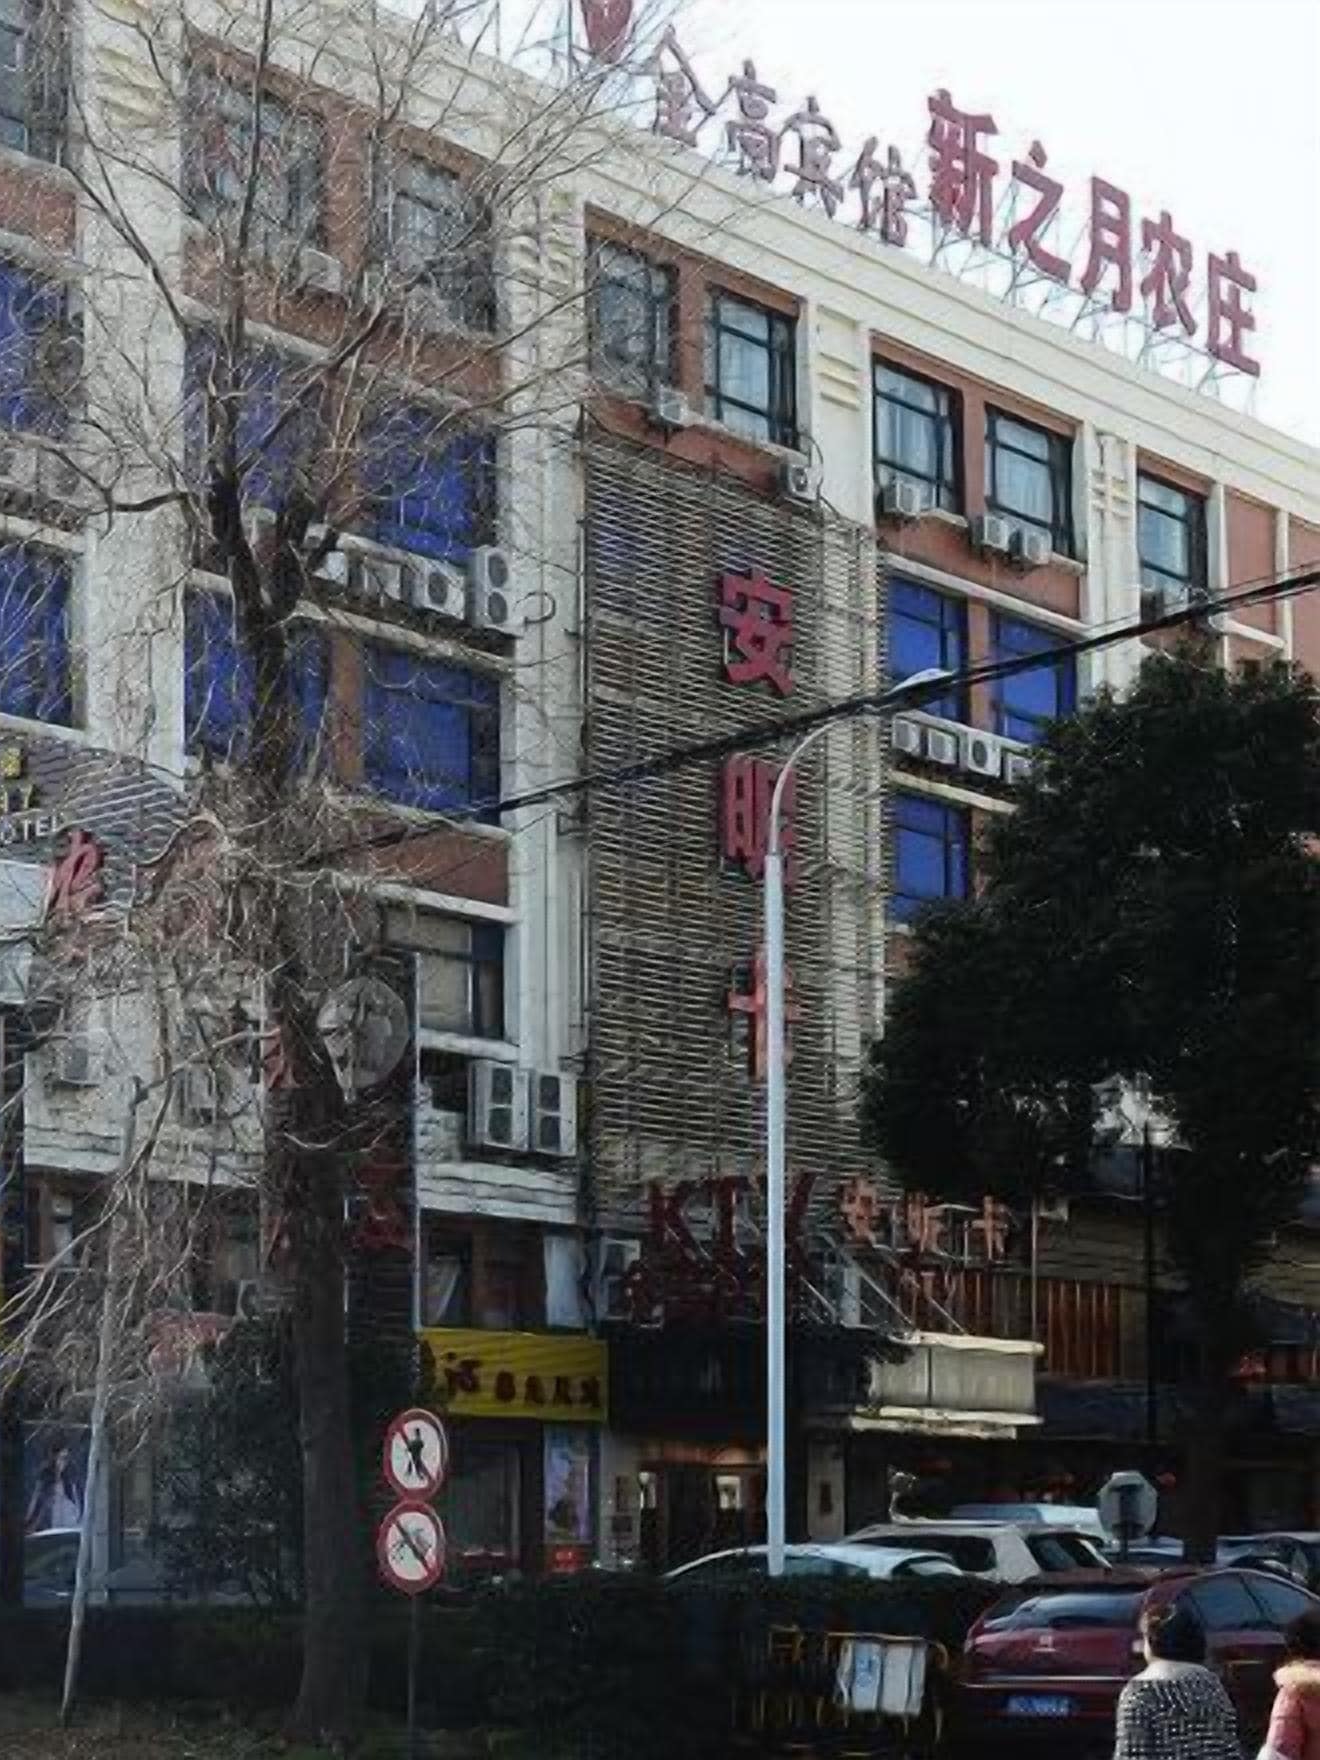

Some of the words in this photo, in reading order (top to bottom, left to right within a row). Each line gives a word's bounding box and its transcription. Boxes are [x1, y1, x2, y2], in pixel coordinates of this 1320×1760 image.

[927, 88, 1261, 377] 新之月农庄
